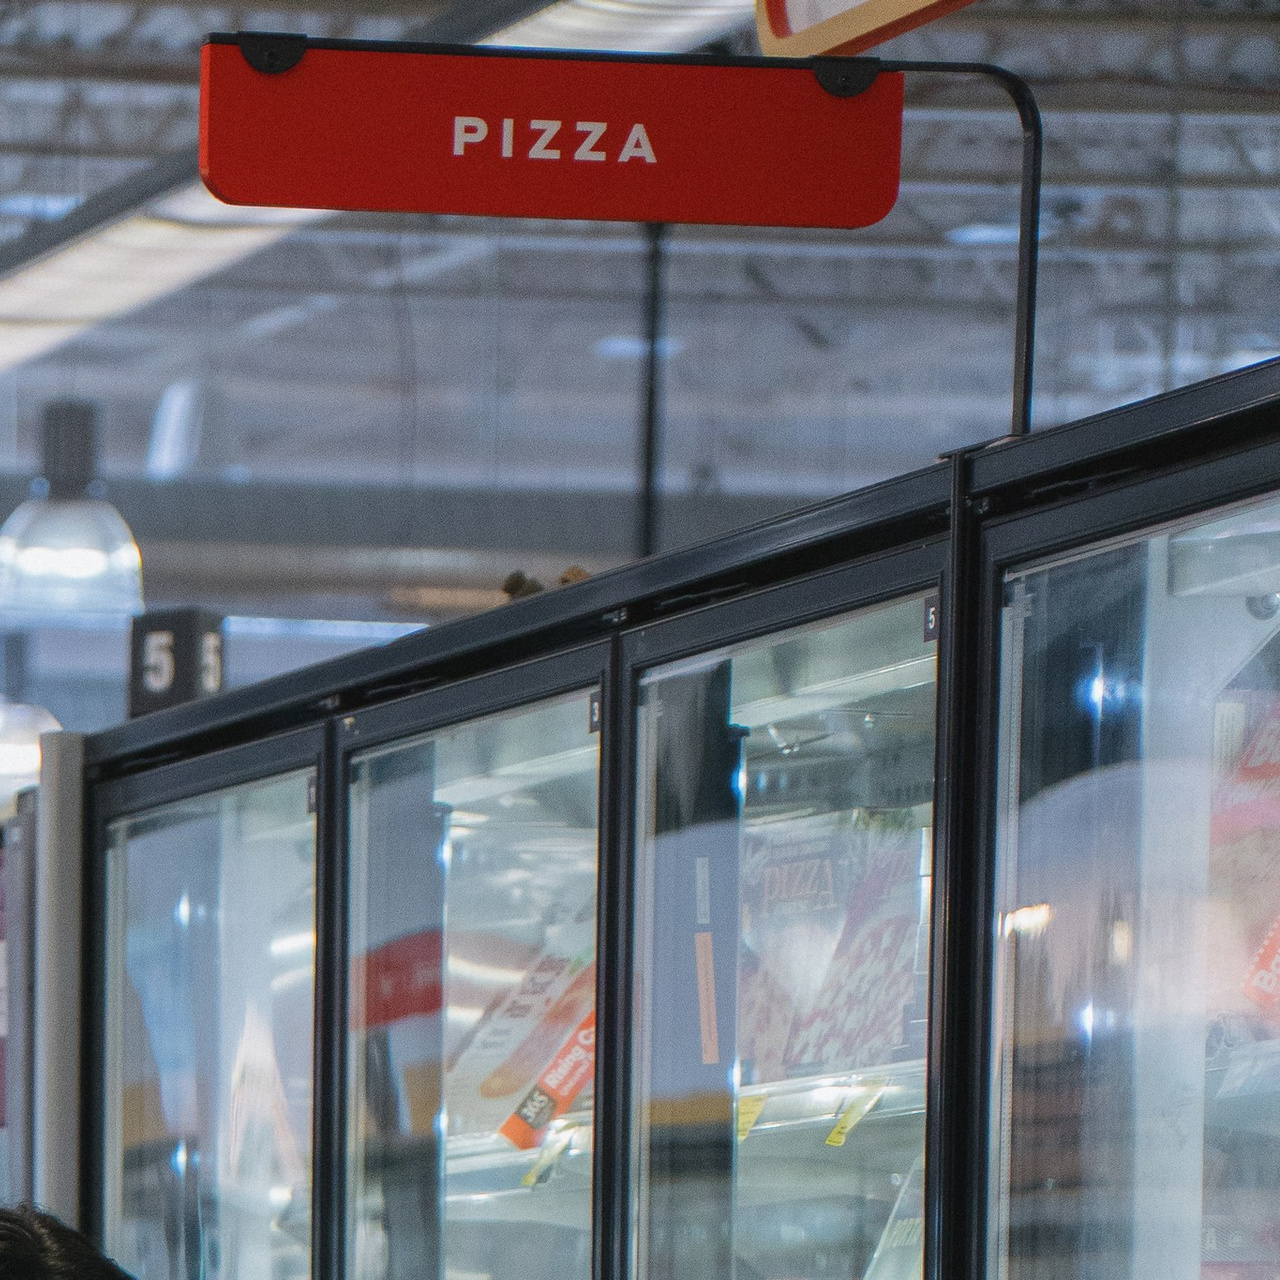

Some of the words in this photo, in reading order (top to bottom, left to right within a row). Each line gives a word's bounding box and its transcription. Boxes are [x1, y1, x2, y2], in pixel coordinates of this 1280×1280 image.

[453, 116, 658, 163] PIZZA
[928, 606, 936, 630] 5
[142, 629, 175, 693] 5
[760, 859, 838, 917] PIZZA
[543, 1043, 588, 1090] Rising
[519, 1088, 550, 1121] 365
